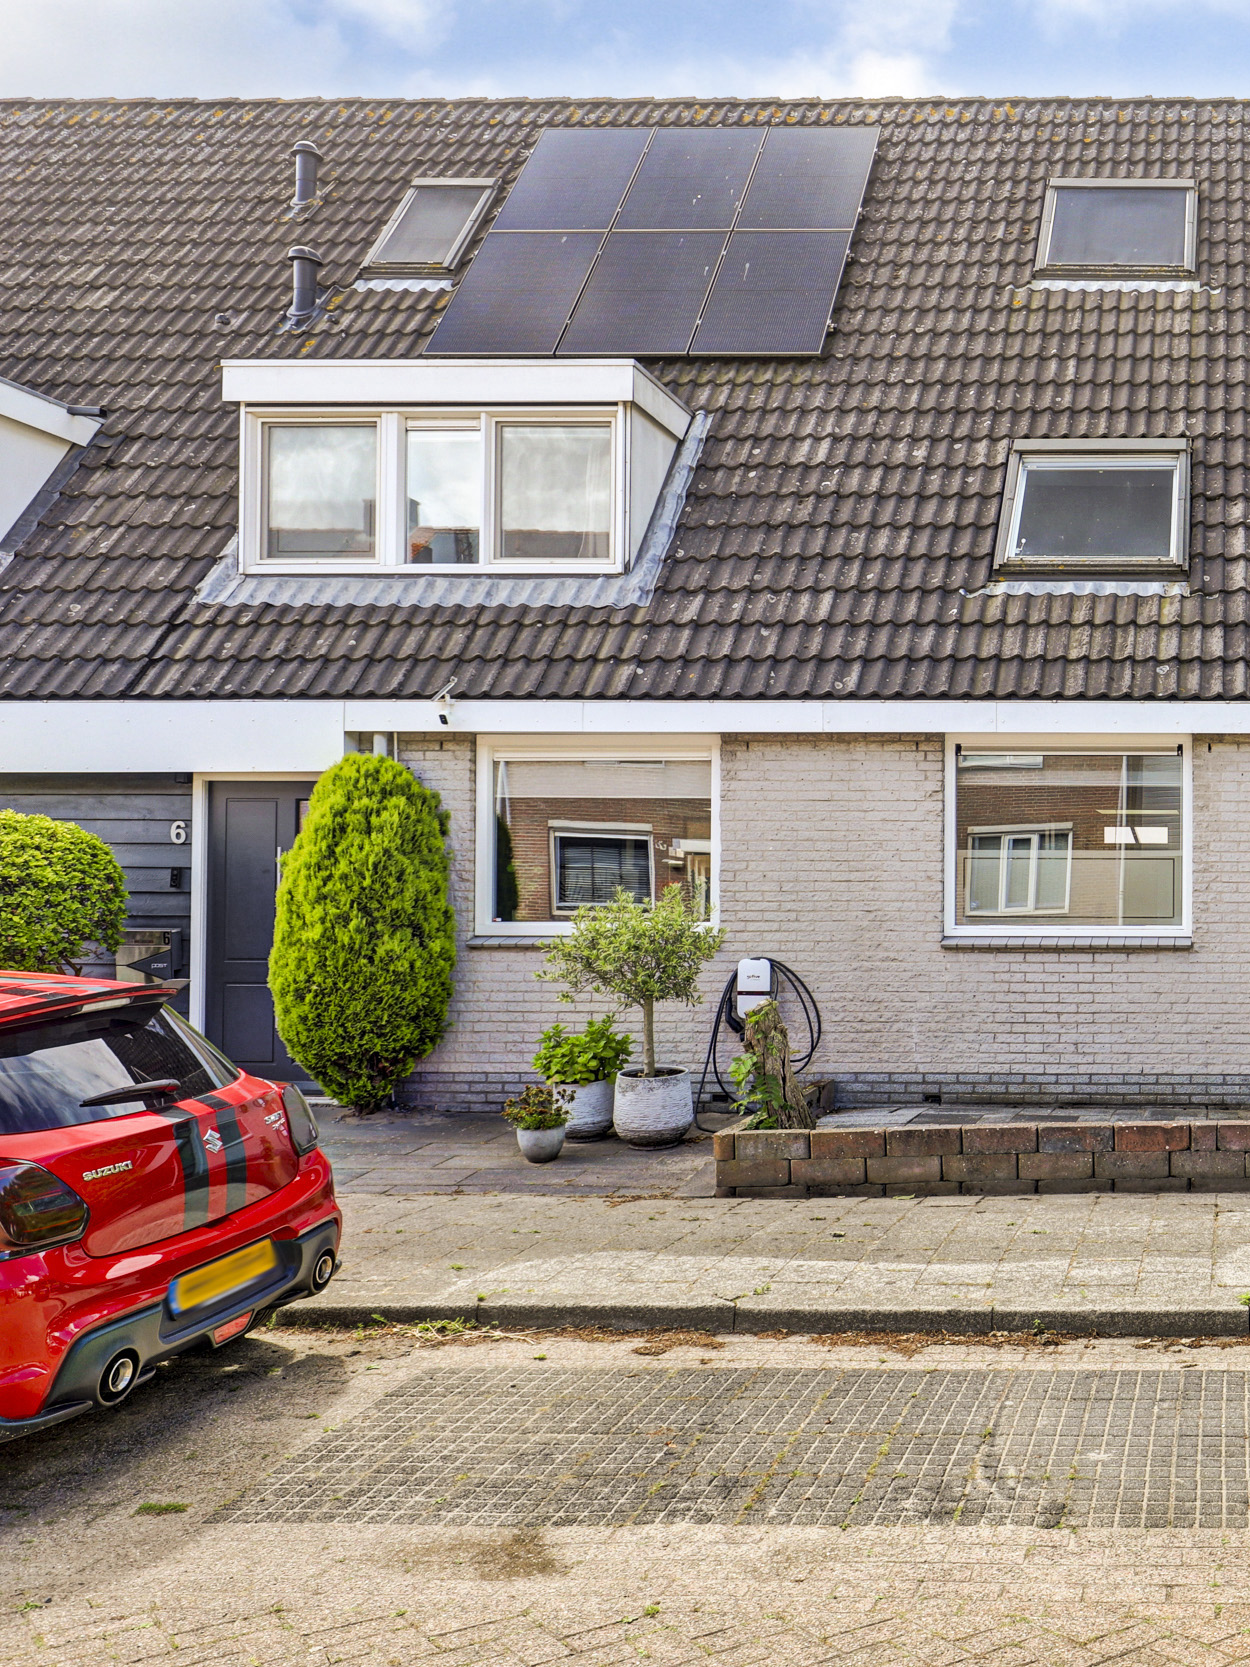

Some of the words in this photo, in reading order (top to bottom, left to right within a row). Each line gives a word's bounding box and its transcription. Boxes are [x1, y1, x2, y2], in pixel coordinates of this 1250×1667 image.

[170, 820, 187, 844] 6
[163, 931, 170, 945] 6
[82, 1160, 133, 1181] SUZUKI
